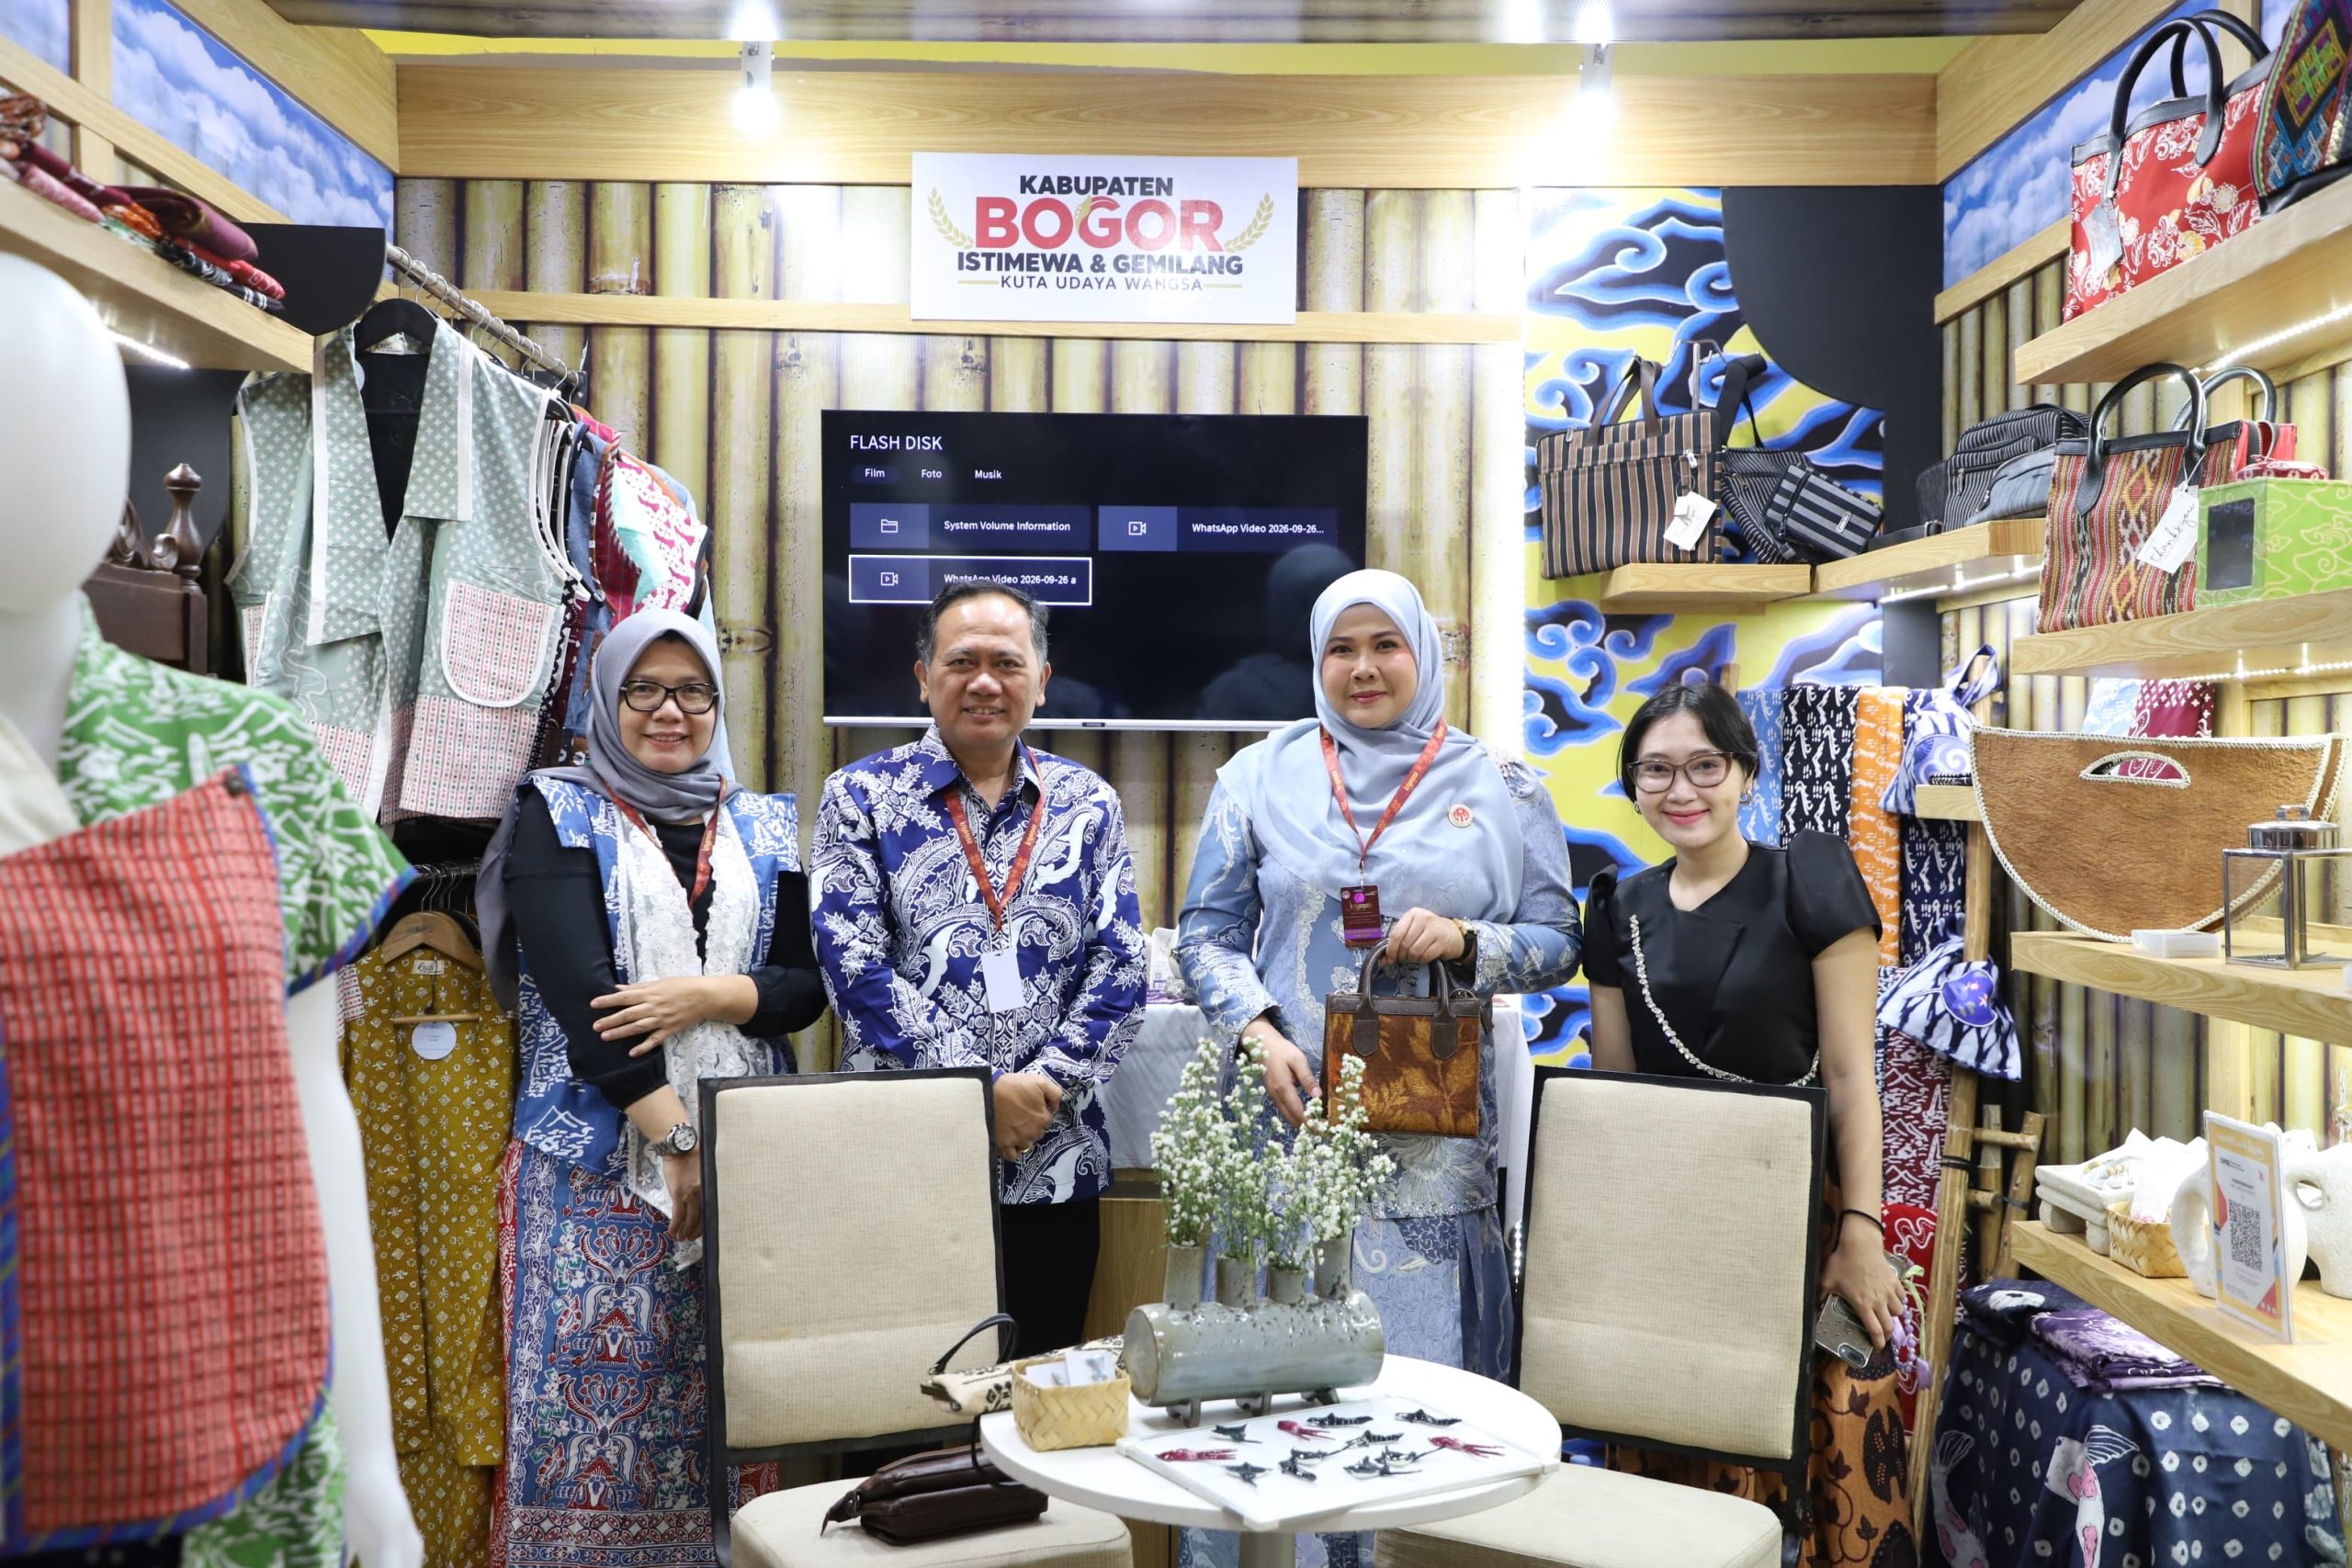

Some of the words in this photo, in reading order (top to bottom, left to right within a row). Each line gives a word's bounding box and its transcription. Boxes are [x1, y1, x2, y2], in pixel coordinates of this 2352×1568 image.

[1020, 175, 1173, 197] KABUPATEN
[975, 195, 1224, 252] BOGOR
[957, 252, 1083, 273] ISTIMEWA
[1090, 254, 1106, 273] &
[1113, 254, 1244, 276] GEMILANG
[1001, 276, 1047, 289] KUTA
[1056, 276, 1116, 290] UDAYA
[1125, 277, 1203, 291] WANGSA
[850, 434, 900, 450] FLASH
[905, 435, 944, 451] DISK
[865, 468, 886, 478] Film
[921, 468, 943, 479] Foto
[974, 469, 1002, 479] Musik
[944, 520, 978, 532] System
[979, 521, 1014, 531] Volume
[1017, 521, 1071, 531] Information
[1192, 523, 1238, 535] WhatsApp
[1240, 524, 1267, 534] Video
[992, 573, 1018, 583] Video
[1020, 574, 1069, 585] 2026-09-26
